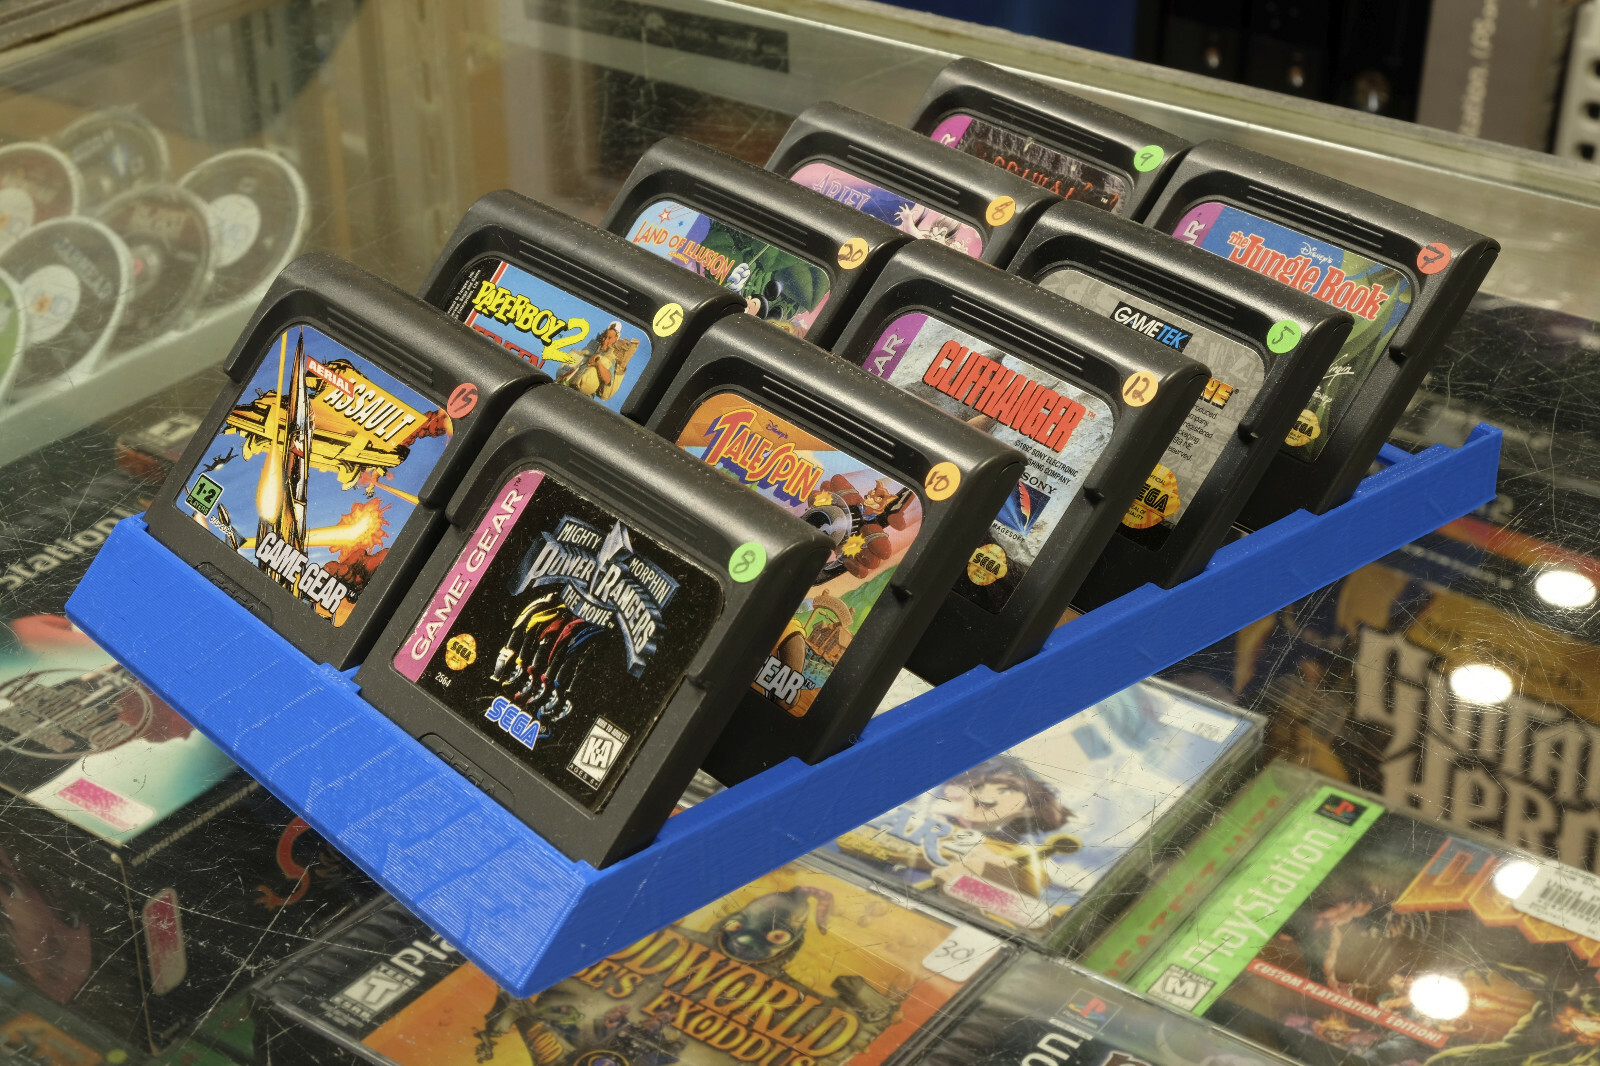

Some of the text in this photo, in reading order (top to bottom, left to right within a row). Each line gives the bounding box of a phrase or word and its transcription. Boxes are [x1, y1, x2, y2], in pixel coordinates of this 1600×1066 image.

[632, 220, 668, 246] LAND
[668, 234, 687, 250] OF
[683, 240, 735, 286] ILLUSION
[838, 244, 863, 262] 20
[1228, 233, 1321, 293] Jungle
[1313, 266, 1389, 321] Book
[472, 280, 590, 364] PAPERBOY 2
[655, 310, 682, 331] 15
[1114, 306, 1188, 349] GAMETEK
[869, 332, 905, 377] AR
[308, 359, 351, 395] AERIAL
[922, 339, 1087, 453] CLIFFHANGER
[1124, 375, 1151, 403] 12
[925, 471, 950, 492] 10
[1021, 472, 1058, 495] SONY
[1031, 447, 1048, 461] SONY
[1047, 455, 1079, 478] ELECTRONIC
[186, 496, 209, 516] PLAYERS
[992, 522, 1025, 544] MAGESOFT
[256, 531, 309, 584] GAME
[298, 562, 348, 614] GEAR
[411, 574, 471, 661] GAME
[466, 488, 525, 574] GEAR
[556, 522, 673, 606] MIGHTY MORPHIN
[972, 552, 1001, 576] SEGA
[523, 540, 657, 655] POWER RANGERS
[563, 587, 613, 628] THE MOVIE
[450, 640, 472, 662] SEGA
[434, 671, 452, 688] 2564
[754, 655, 805, 705] EAR
[485, 695, 540, 750] SEGA
[569, 763, 587, 780] AGES
[1181, 827, 1340, 974] PlayStation
[606, 930, 860, 1058] DWORLD
[1253, 962, 1443, 1045] CUSTOM PLAYSTATION EDITION!
